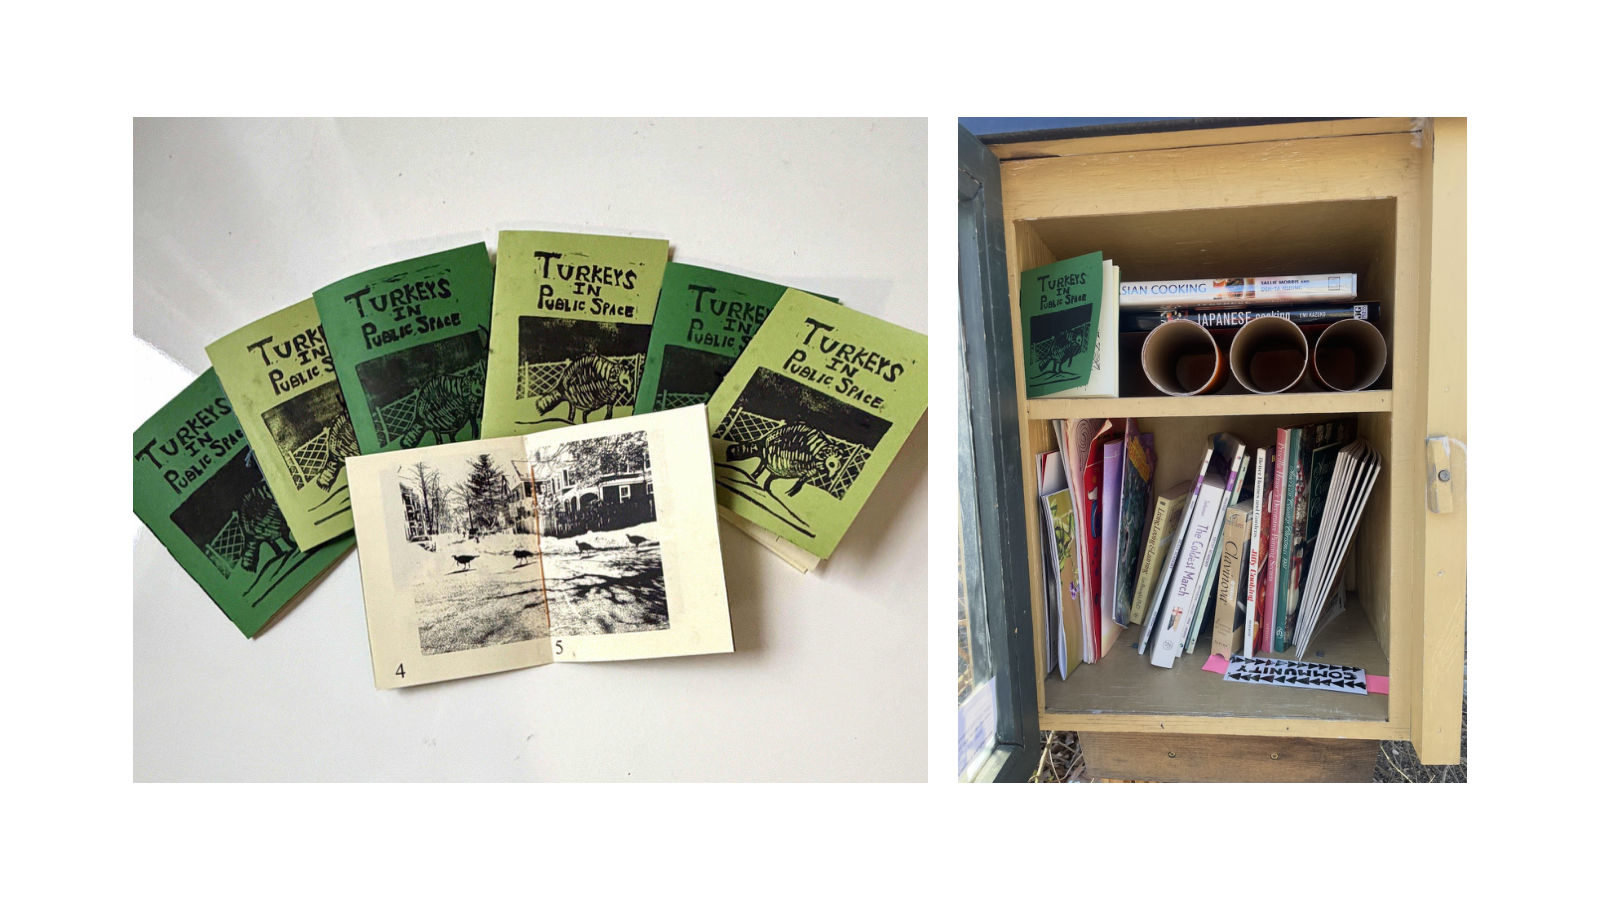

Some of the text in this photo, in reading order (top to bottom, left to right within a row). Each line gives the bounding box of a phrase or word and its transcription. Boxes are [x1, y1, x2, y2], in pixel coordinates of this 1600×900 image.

[534, 251, 637, 290] TURKEYS
[1037, 272, 1087, 292] TURKEYS
[343, 277, 452, 318] TURKEYS
[537, 284, 634, 318] PUBLIC SPACE
[573, 282, 601, 297] IN
[1040, 293, 1087, 310] PUBLIC SPACE
[1056, 287, 1070, 296] IN
[1119, 283, 1207, 296] SIAN COOKING
[392, 304, 421, 322] IN
[688, 284, 774, 323] TURKE
[361, 312, 462, 350] PUBLIC SPACE
[723, 318, 752, 334] IN
[1197, 311, 1252, 327] JAPANESE
[246, 323, 328, 366] TURK
[687, 318, 735, 348] PUBLIC
[297, 345, 326, 366] IN
[803, 317, 905, 383] TURKEYS
[268, 365, 320, 396] PUBLIC
[782, 348, 885, 409] PUBLIC SPACE
[825, 357, 859, 379] IN
[135, 397, 232, 469] TURKEYS
[183, 432, 213, 457] IN
[163, 429, 244, 494] PUBLIC SPAC
[1195, 525, 1208, 539] The
[1186, 541, 1204, 569] Coldest
[1178, 570, 1196, 597] March
[1219, 541, 1238, 602] Clavinova
[1247, 549, 1258, 602] Jiffy Cooking
[555, 640, 564, 655] 5
[395, 662, 406, 679] 4
[1237, 665, 1357, 681] COMMUNITY
